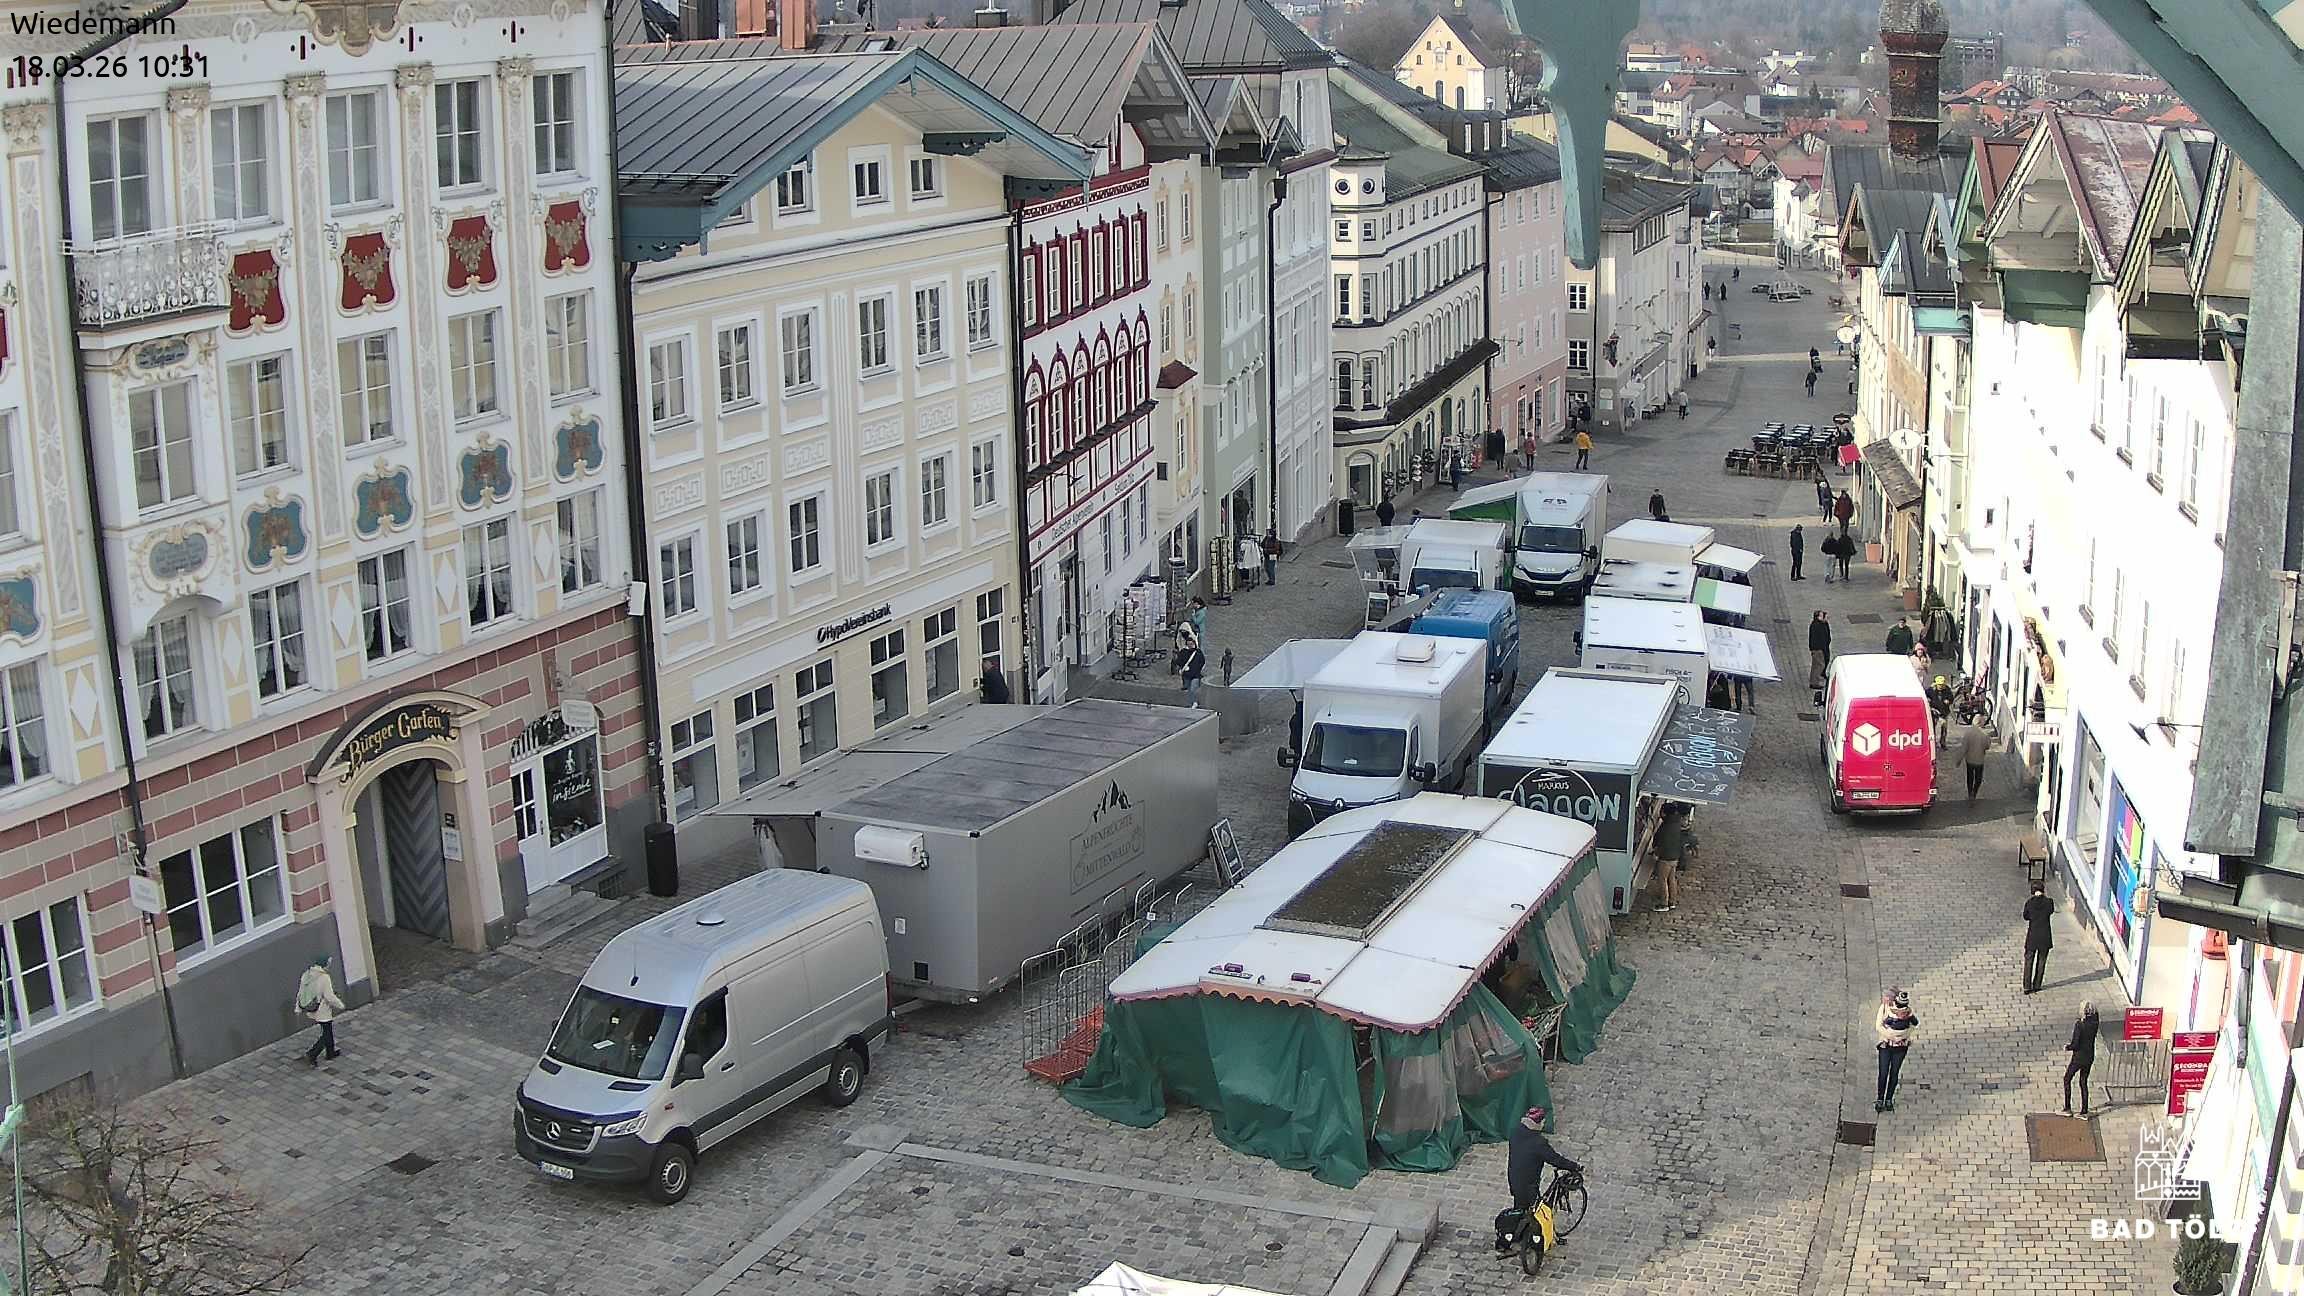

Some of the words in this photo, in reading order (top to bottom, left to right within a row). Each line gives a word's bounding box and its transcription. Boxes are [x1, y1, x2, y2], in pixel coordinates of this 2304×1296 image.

[826, 602, 892, 641] HypoVereinsbank
[350, 722, 394, 768] Bürger
[397, 707, 442, 739] Garten
[1887, 728, 1923, 751] dpd
